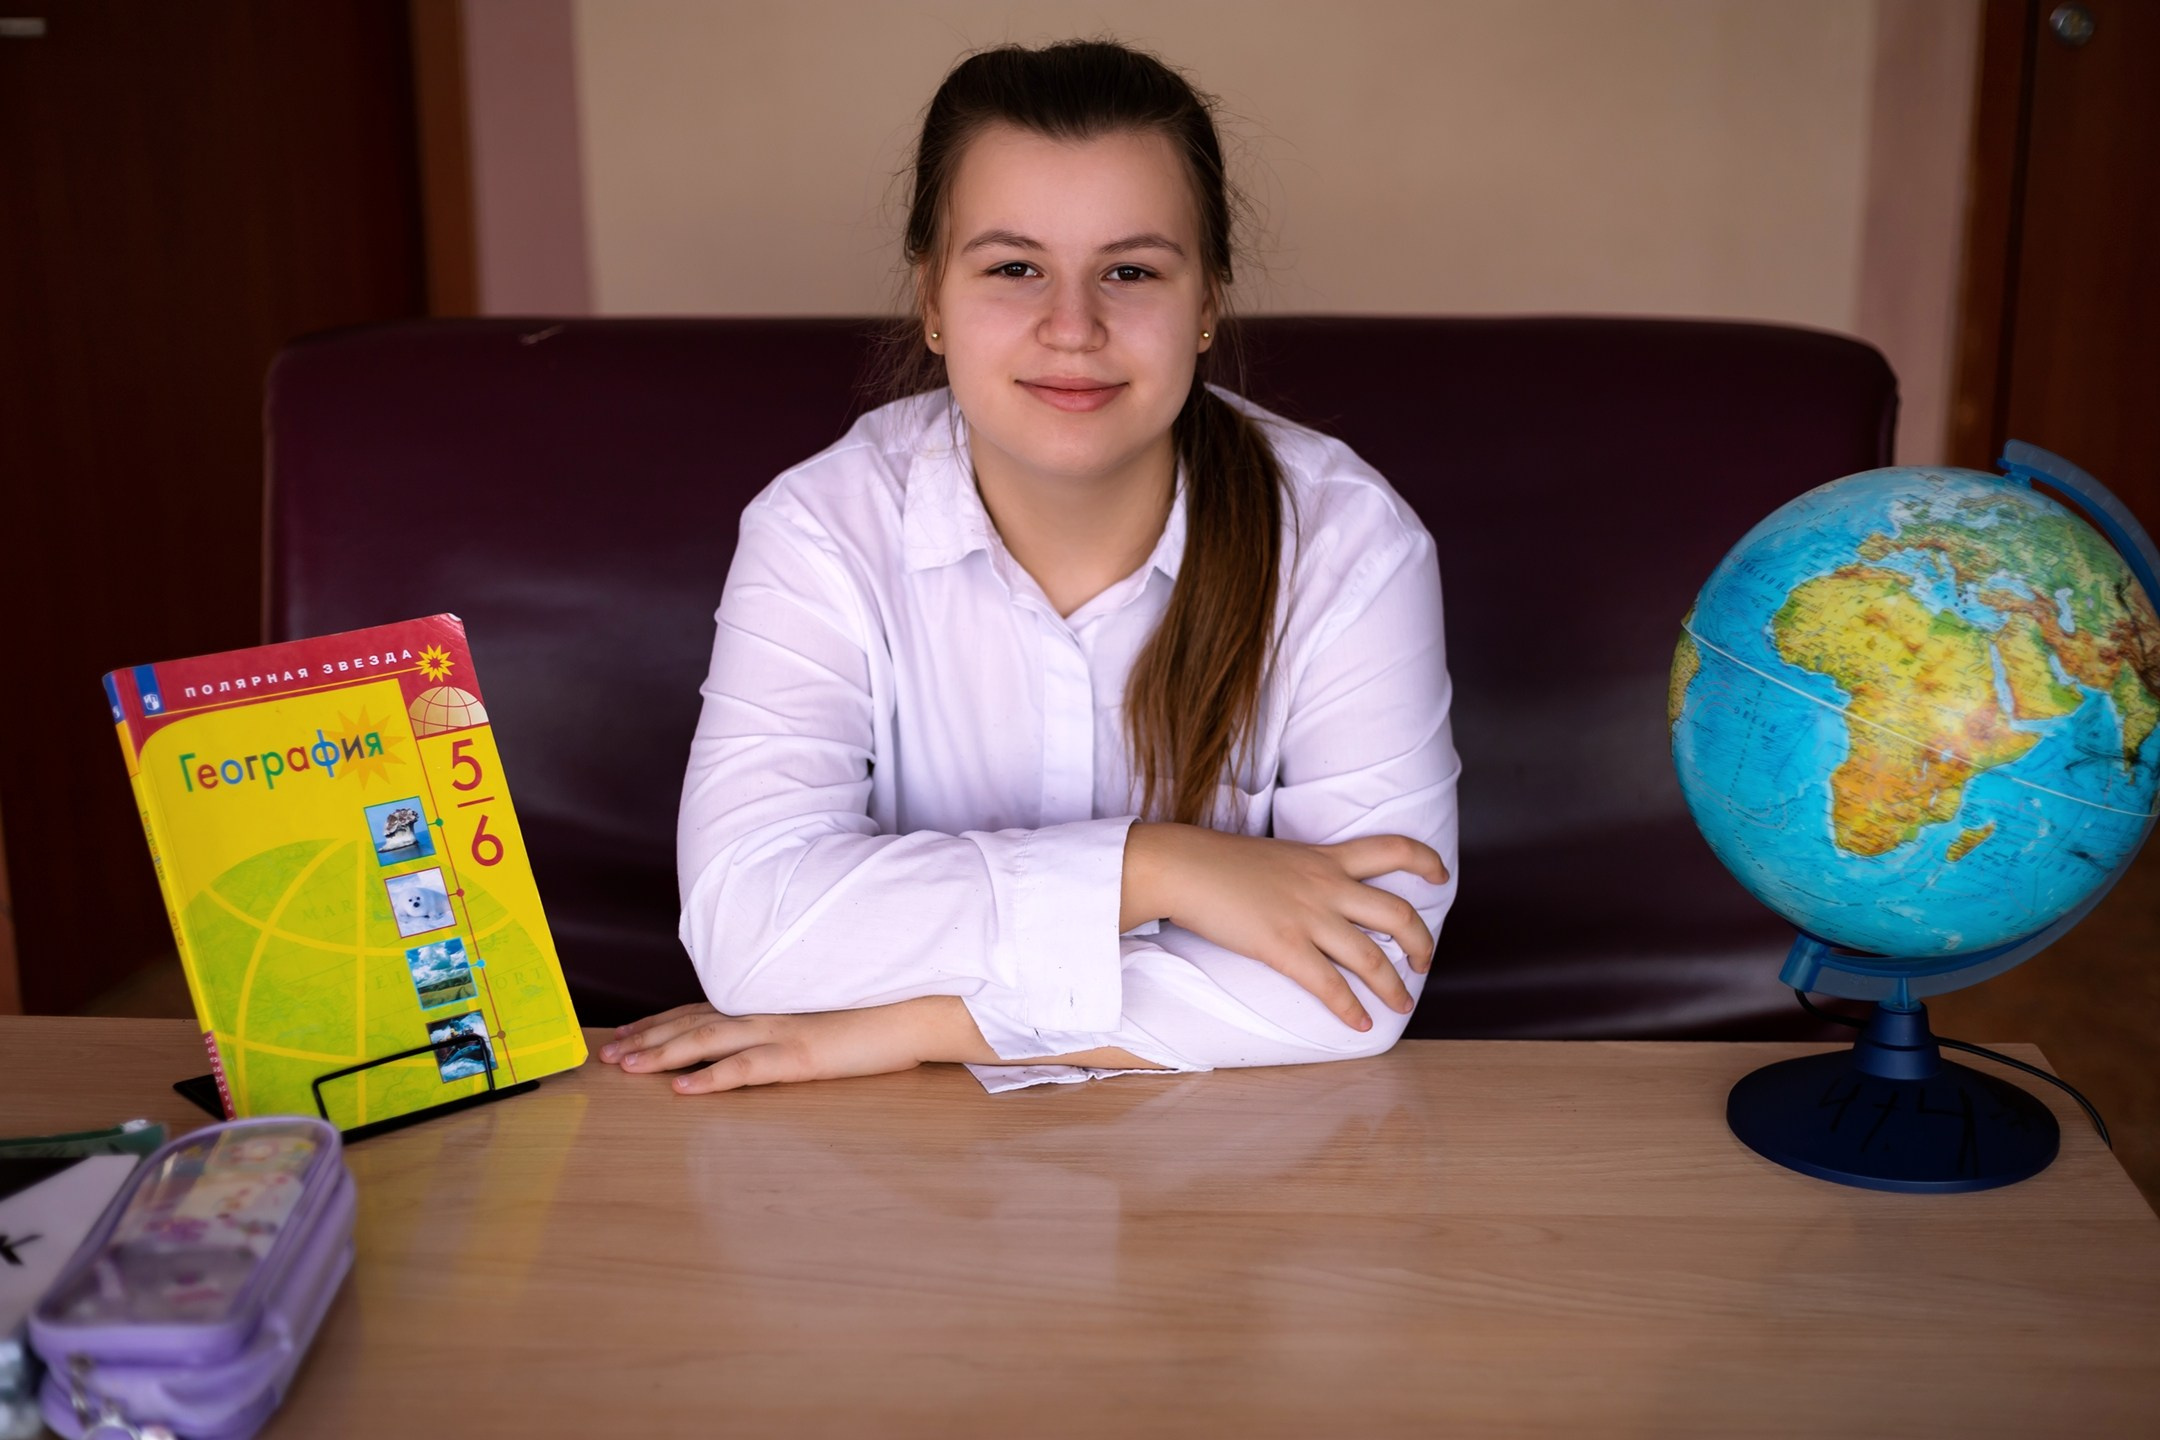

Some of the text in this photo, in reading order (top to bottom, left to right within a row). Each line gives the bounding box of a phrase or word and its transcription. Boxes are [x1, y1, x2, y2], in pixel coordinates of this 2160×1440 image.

[184, 649, 413, 698] ПОЛЯРНАЯ ЗВЕЗДА
[178, 729, 385, 793] География
[451, 738, 483, 792] 5
[471, 814, 504, 867] 6
